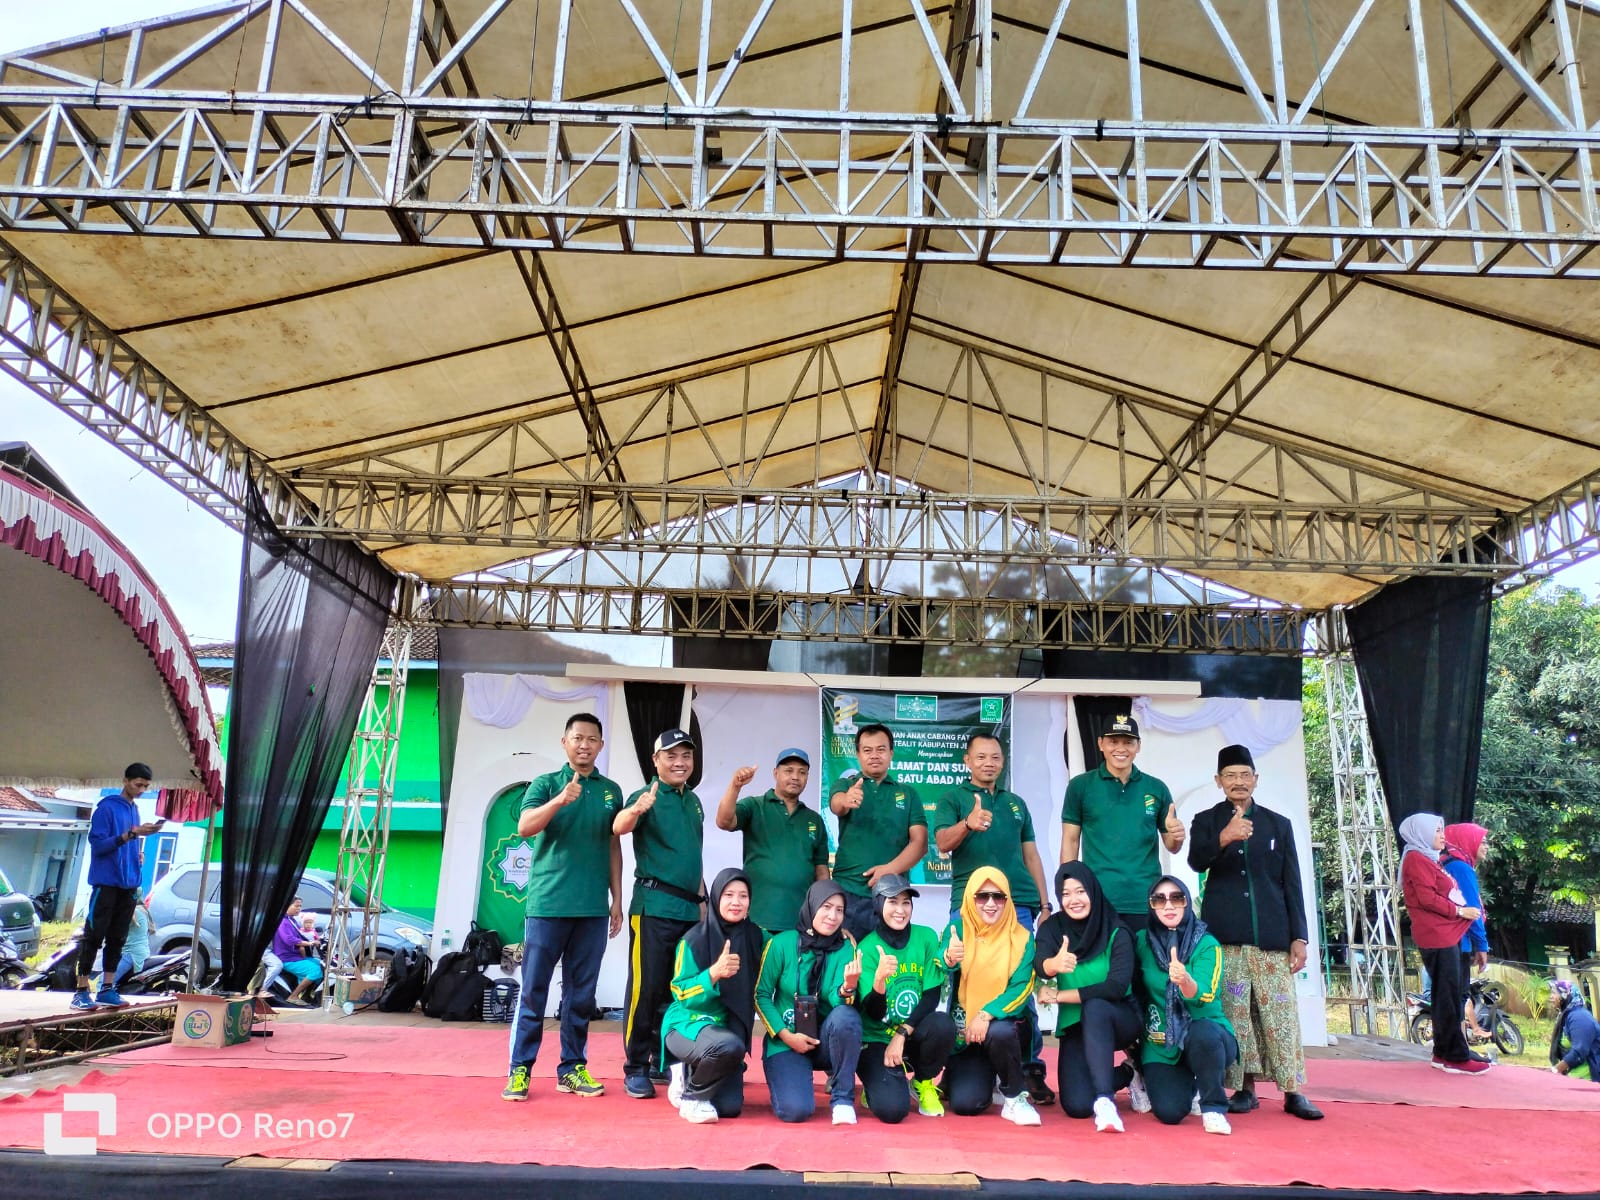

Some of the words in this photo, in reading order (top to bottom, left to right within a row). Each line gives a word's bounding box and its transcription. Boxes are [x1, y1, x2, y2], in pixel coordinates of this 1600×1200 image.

[927, 733, 956, 741] CABANG
[893, 740, 916, 748] TEALIT
[918, 741, 959, 749] KABUPATEN
[889, 760, 925, 771] LAMAT
[927, 762, 949, 772] DAN
[897, 773, 924, 783] SATU
[926, 774, 954, 785] ABAD
